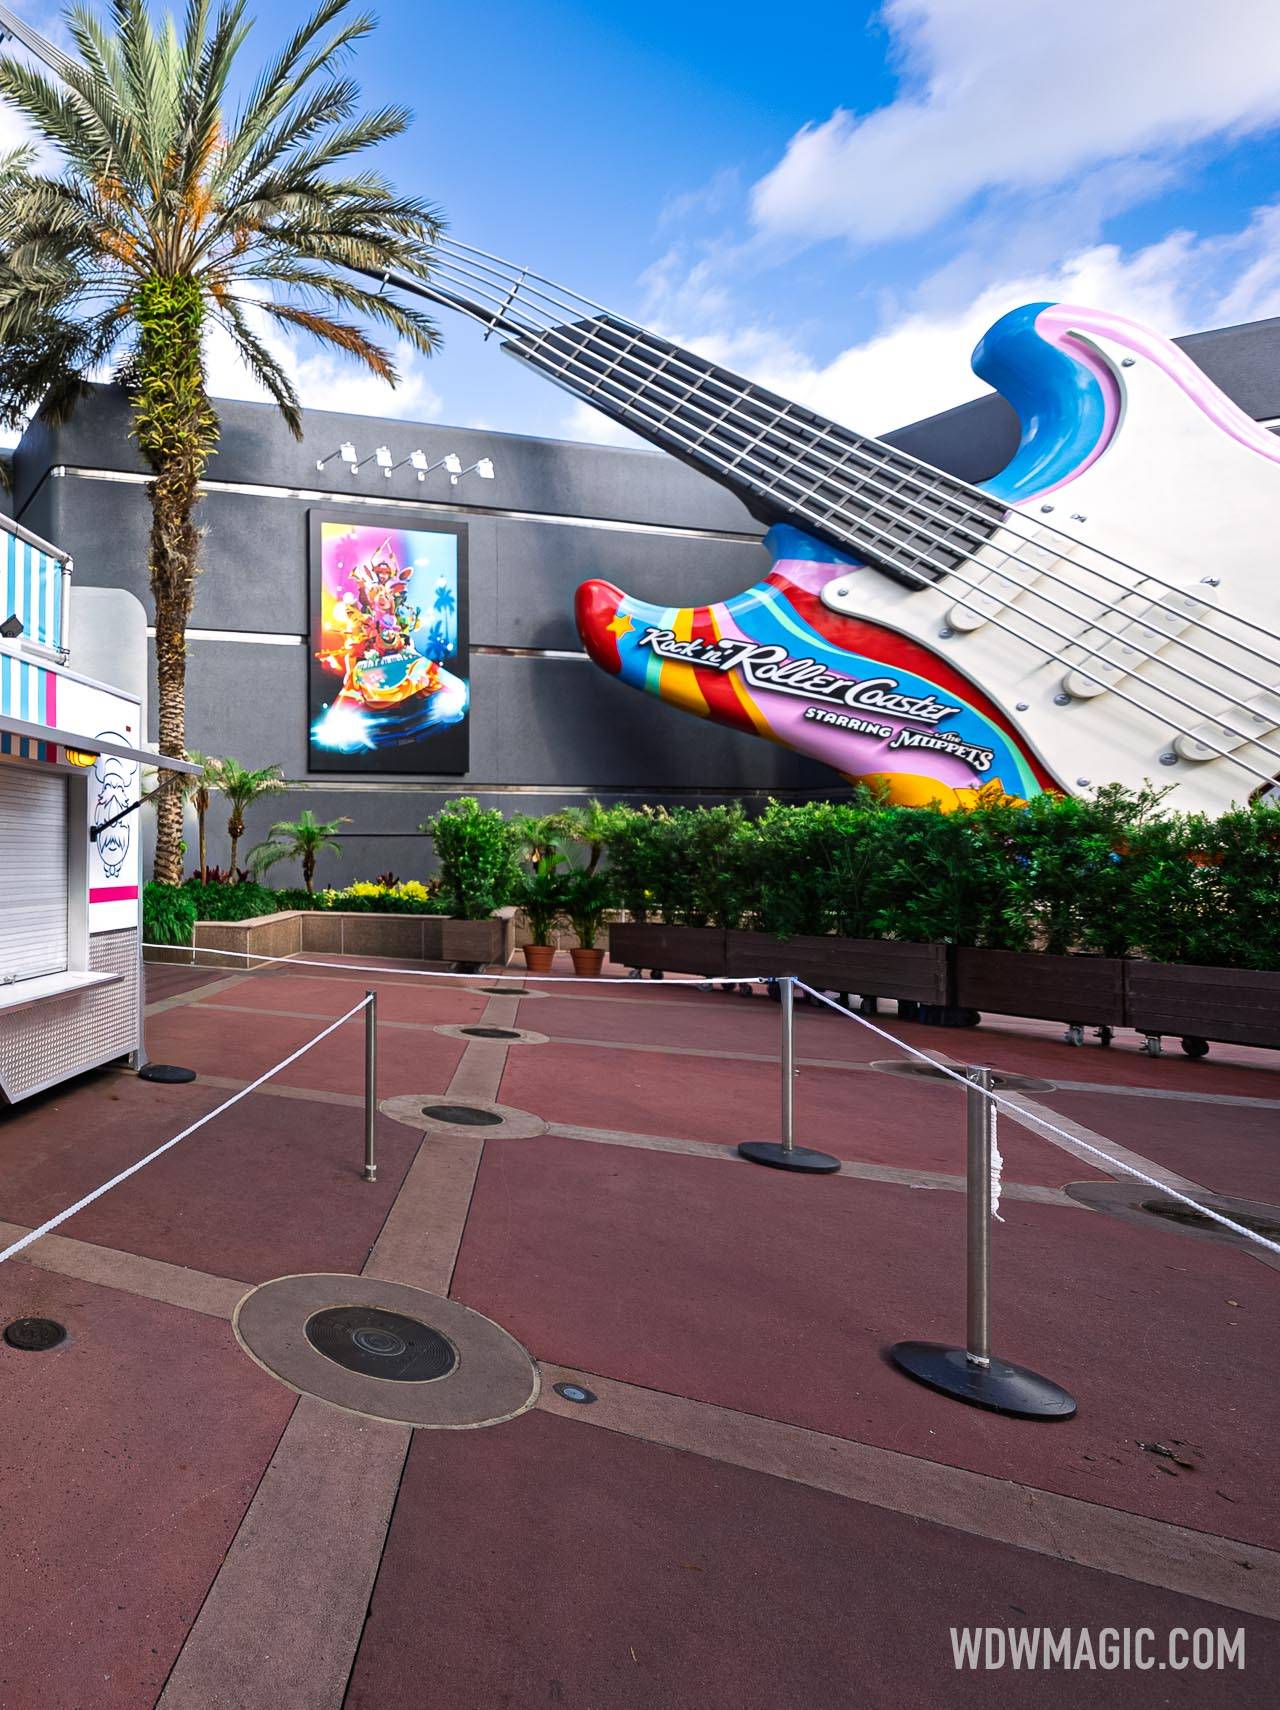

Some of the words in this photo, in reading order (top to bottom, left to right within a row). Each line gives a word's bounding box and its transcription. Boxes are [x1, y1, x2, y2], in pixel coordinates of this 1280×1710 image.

[639, 628, 704, 660] Rock
[719, 638, 856, 700] Roller
[844, 678, 961, 722] Coaster
[805, 708, 892, 738] STARRING
[890, 730, 994, 771] MUPPETS
